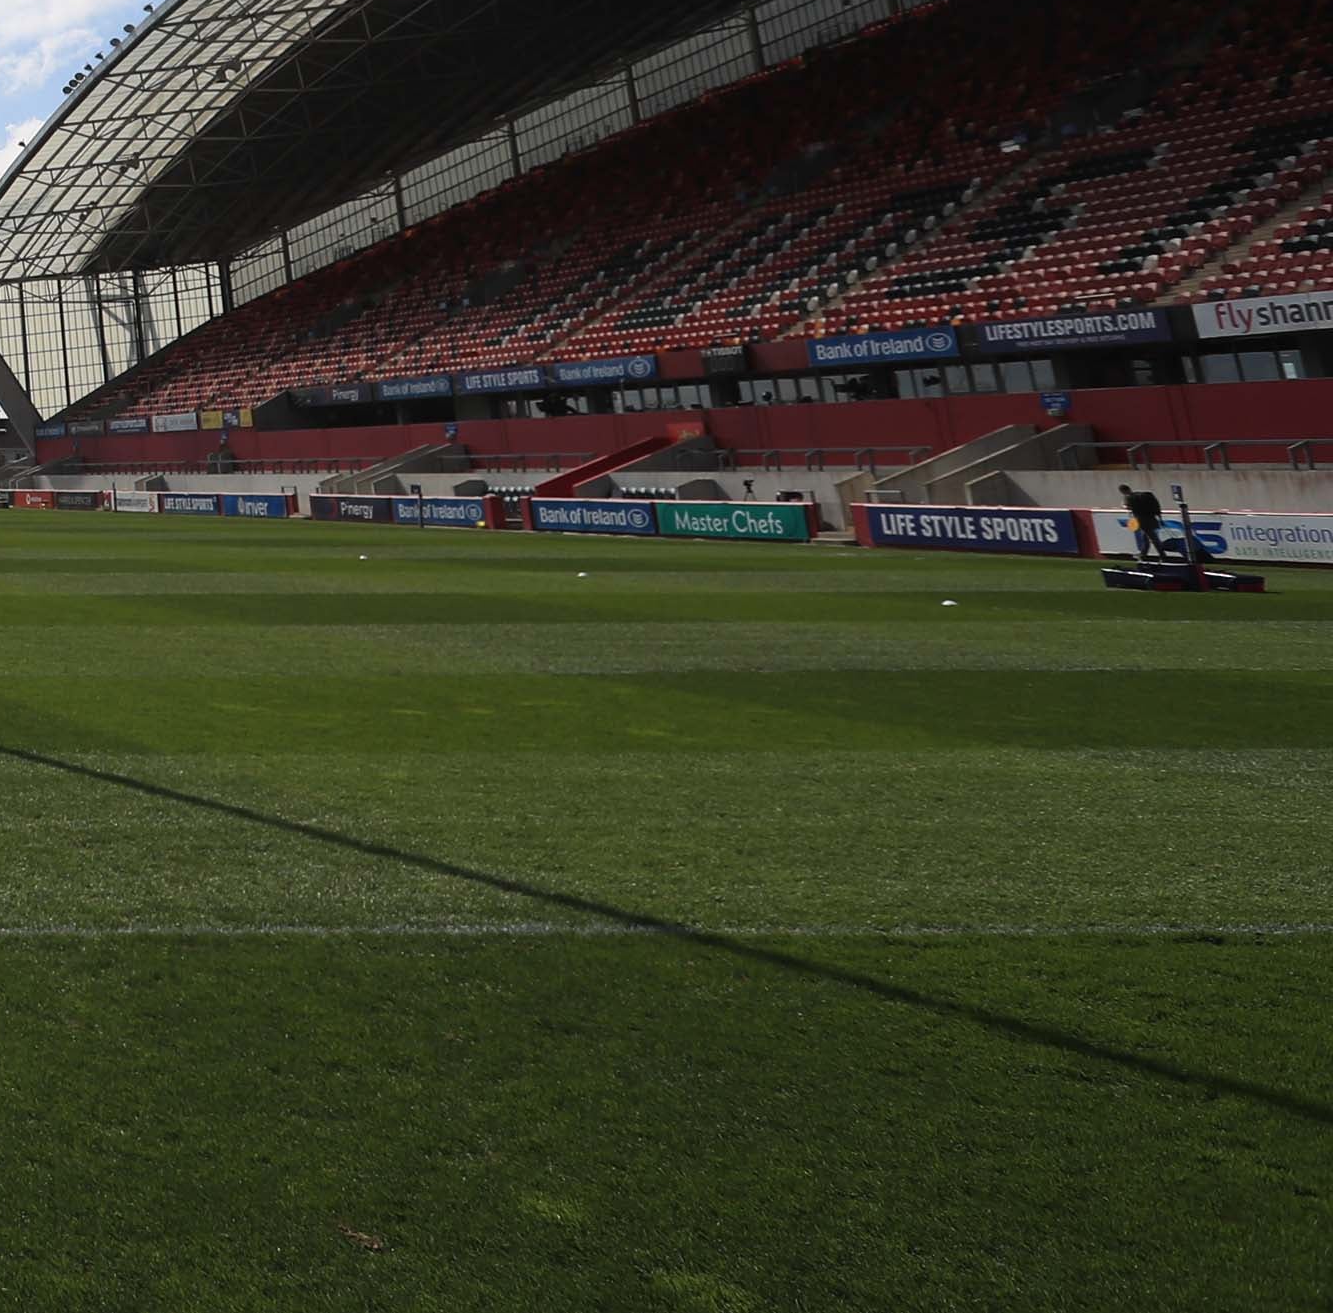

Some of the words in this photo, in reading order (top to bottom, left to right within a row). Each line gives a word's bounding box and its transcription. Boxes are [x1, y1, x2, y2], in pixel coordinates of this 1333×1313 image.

[985, 312, 1156, 341] LIFESTYLESPORTS.COM
[816, 344, 853, 360] Bank
[855, 341, 872, 356] of
[871, 336, 924, 355] Ireland
[465, 376, 481, 389] LIFE
[482, 373, 506, 388] STYLE
[507, 369, 539, 386] SPORTS
[559, 368, 582, 381] Bank
[583, 366, 596, 379] of
[593, 364, 625, 378] Ireland
[340, 501, 374, 519] Pinergy
[398, 503, 420, 519] Bank
[432, 503, 465, 520] Ireland
[538, 507, 568, 525] Bank
[568, 508, 582, 525] of
[581, 508, 627, 527] Ireland
[674, 509, 729, 533] Master
[732, 510, 784, 535] Chefs
[880, 512, 918, 537] LIFE
[919, 514, 976, 540] STYLE
[980, 516, 1060, 544] SPORTS
[1229, 522, 1333, 547] integration
